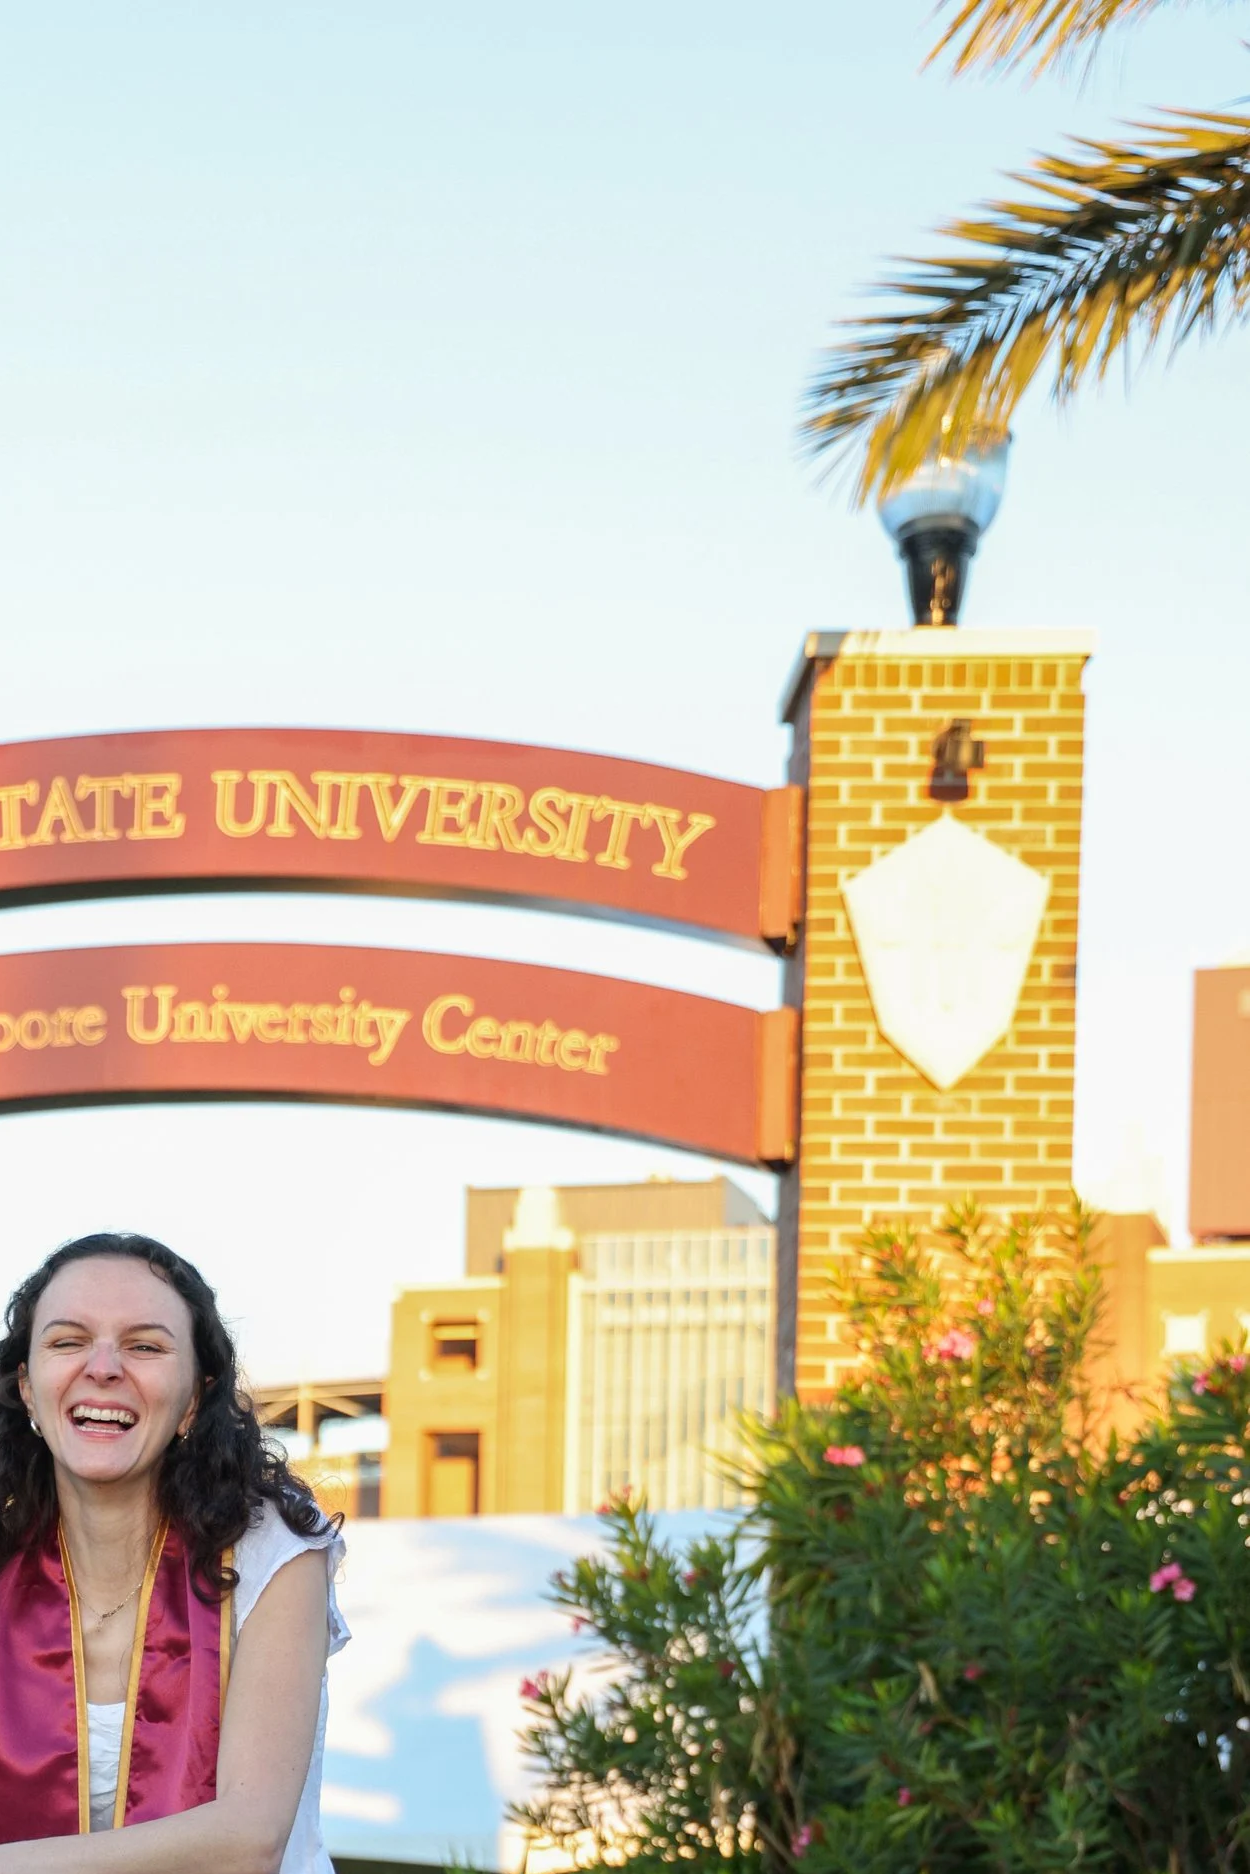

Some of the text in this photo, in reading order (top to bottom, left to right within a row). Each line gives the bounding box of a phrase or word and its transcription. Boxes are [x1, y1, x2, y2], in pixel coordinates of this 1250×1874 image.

[212, 771, 715, 880] UNIVERSITY
[122, 985, 411, 1065] University
[423, 996, 619, 1075] Center
